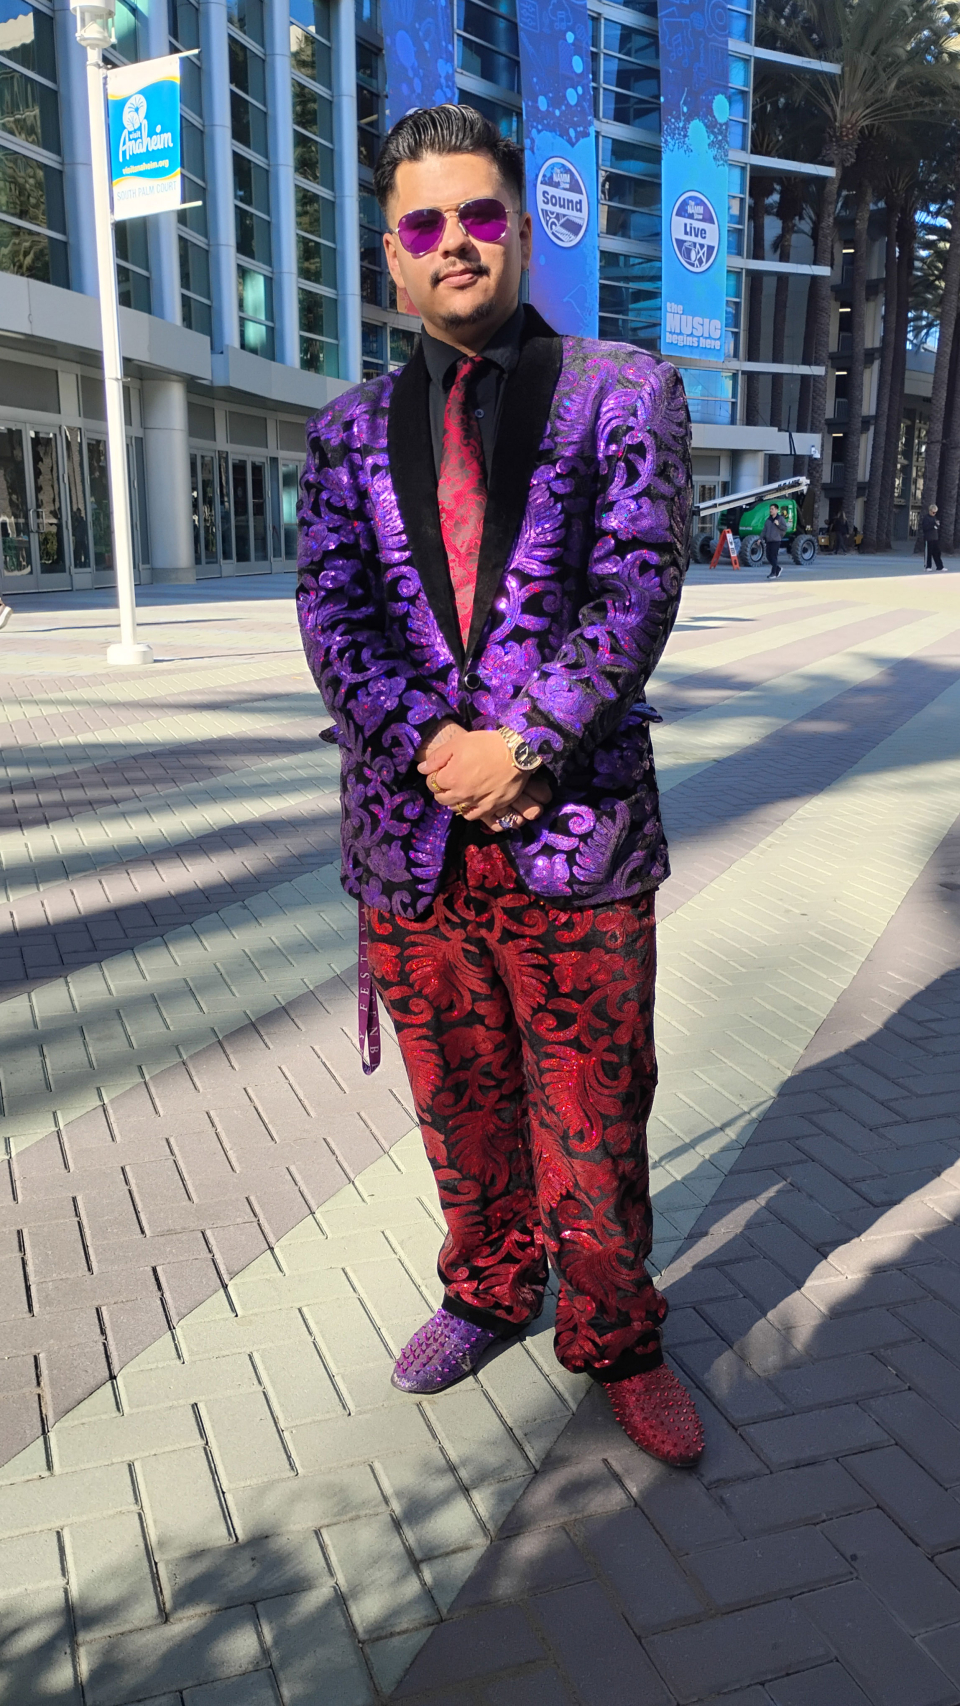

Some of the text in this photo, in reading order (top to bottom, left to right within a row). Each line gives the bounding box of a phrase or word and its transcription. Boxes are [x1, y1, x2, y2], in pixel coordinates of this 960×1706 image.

[119, 119, 173, 162] Anaheim
[117, 181, 176, 201] SOUTH PALM COURT
[542, 190, 583, 213] Sound
[683, 222, 707, 240] Live
[666, 301, 683, 314] the
[666, 312, 721, 338] MUSIC
[666, 332, 721, 350] begins here
